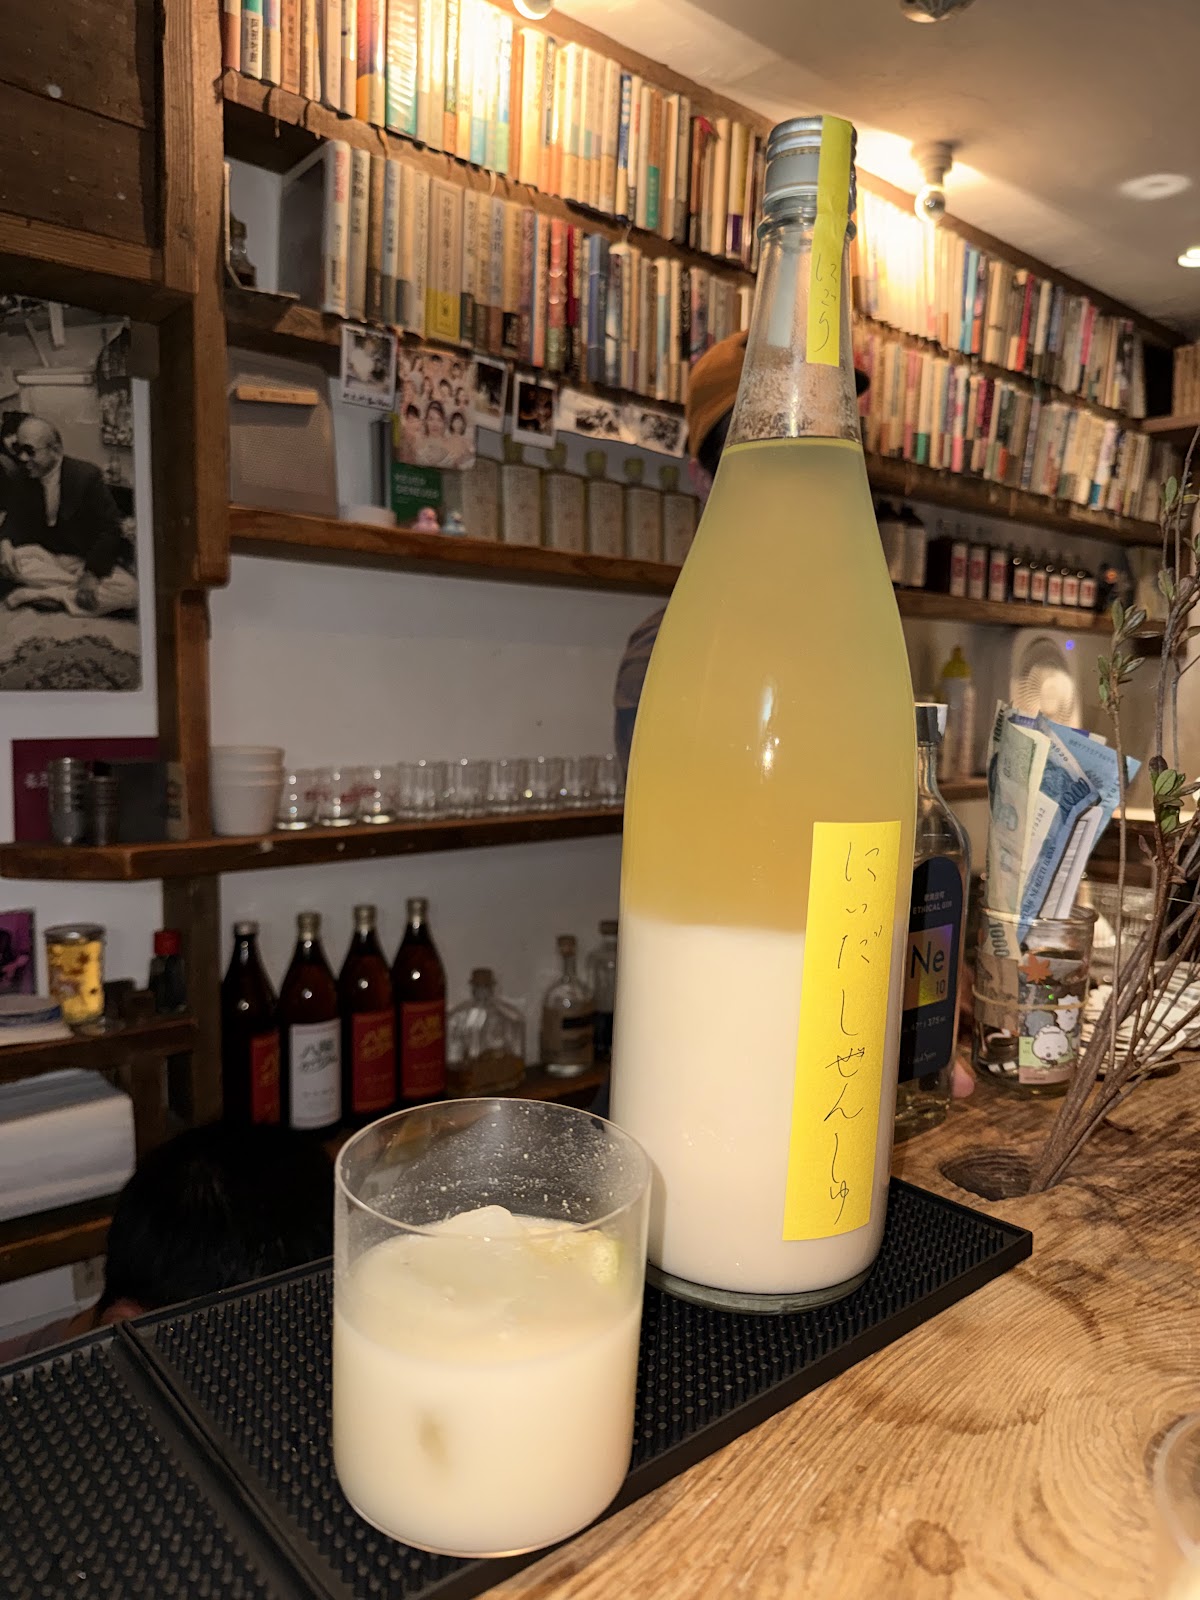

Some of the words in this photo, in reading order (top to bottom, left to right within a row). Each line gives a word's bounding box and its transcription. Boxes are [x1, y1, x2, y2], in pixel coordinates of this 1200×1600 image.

[912, 902, 941, 915] ETHICAL
[941, 900, 953, 909] GIN
[910, 941, 945, 979] Ne
[935, 979, 946, 995] 10
